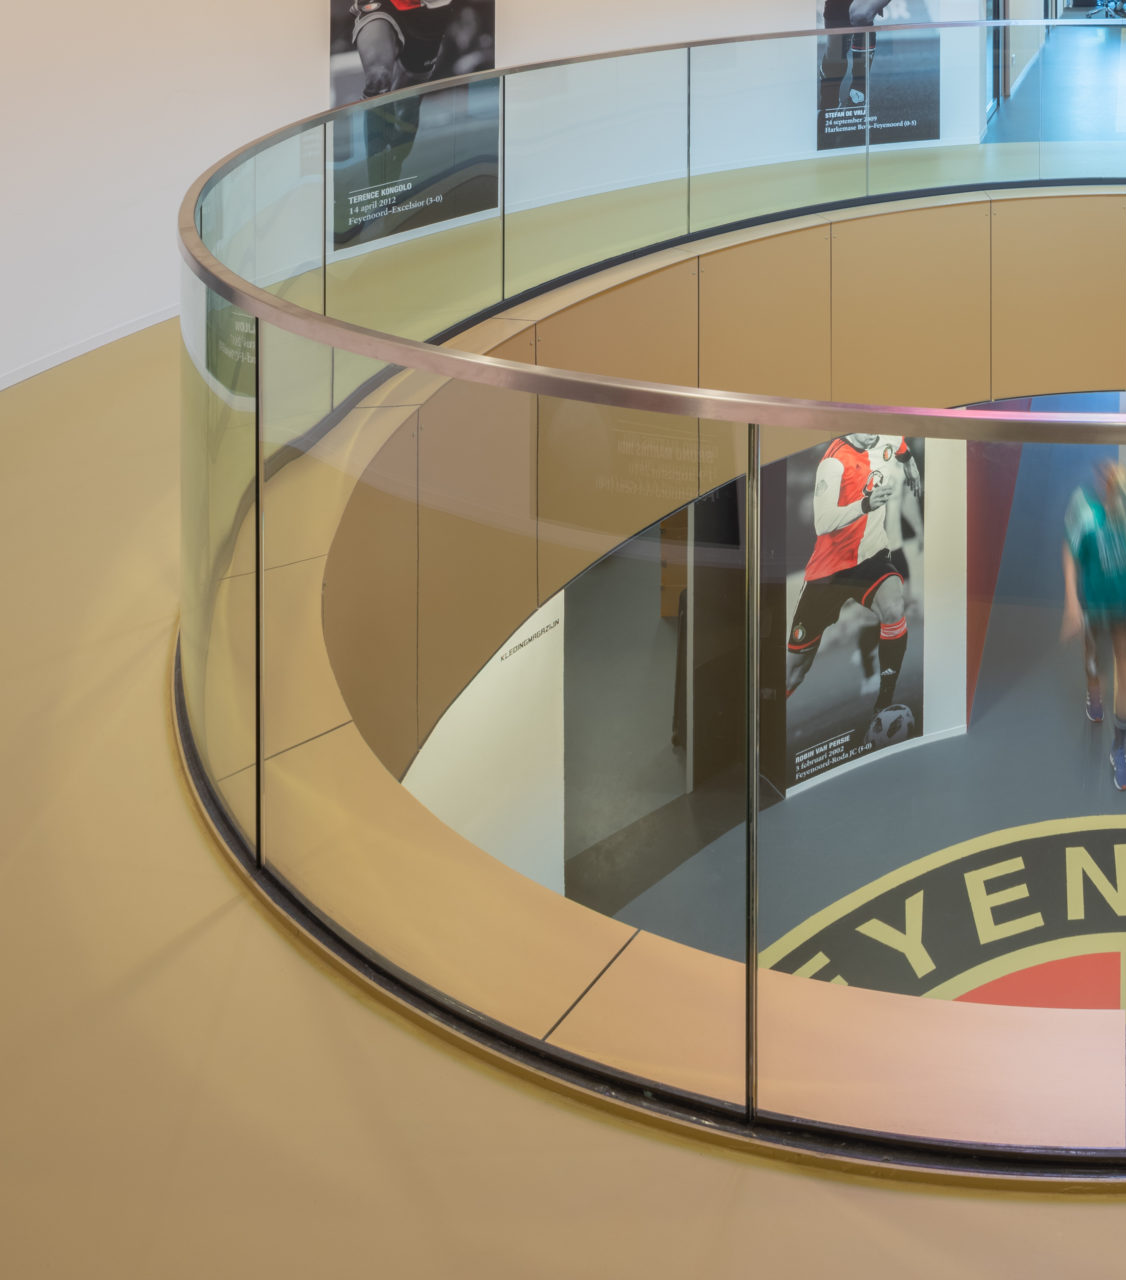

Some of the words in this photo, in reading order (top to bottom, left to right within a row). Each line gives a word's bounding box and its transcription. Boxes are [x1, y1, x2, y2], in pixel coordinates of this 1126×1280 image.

[825, 111, 845, 119] STEFAN
[833, 117, 862, 126] september
[825, 125, 857, 134] Harkemase
[348, 190, 380, 205] TERENCE
[381, 183, 413, 197] KONGOLO
[425, 194, 443, 206] (3-0)
[349, 207, 359, 215] 14
[360, 201, 378, 213] april
[379, 196, 397, 207] 2012
[500, 618, 560, 662] KLEDINGMAGAZIJN
[795, 750, 815, 764] ROBIN
[815, 743, 828, 755] VAN
[828, 734, 851, 749] PERSIE
[800, 752, 828, 770] februari
[828, 745, 845, 757] 2002
[795, 752, 849, 780] Feyenoord-Roda
[849, 748, 858, 758] JC
